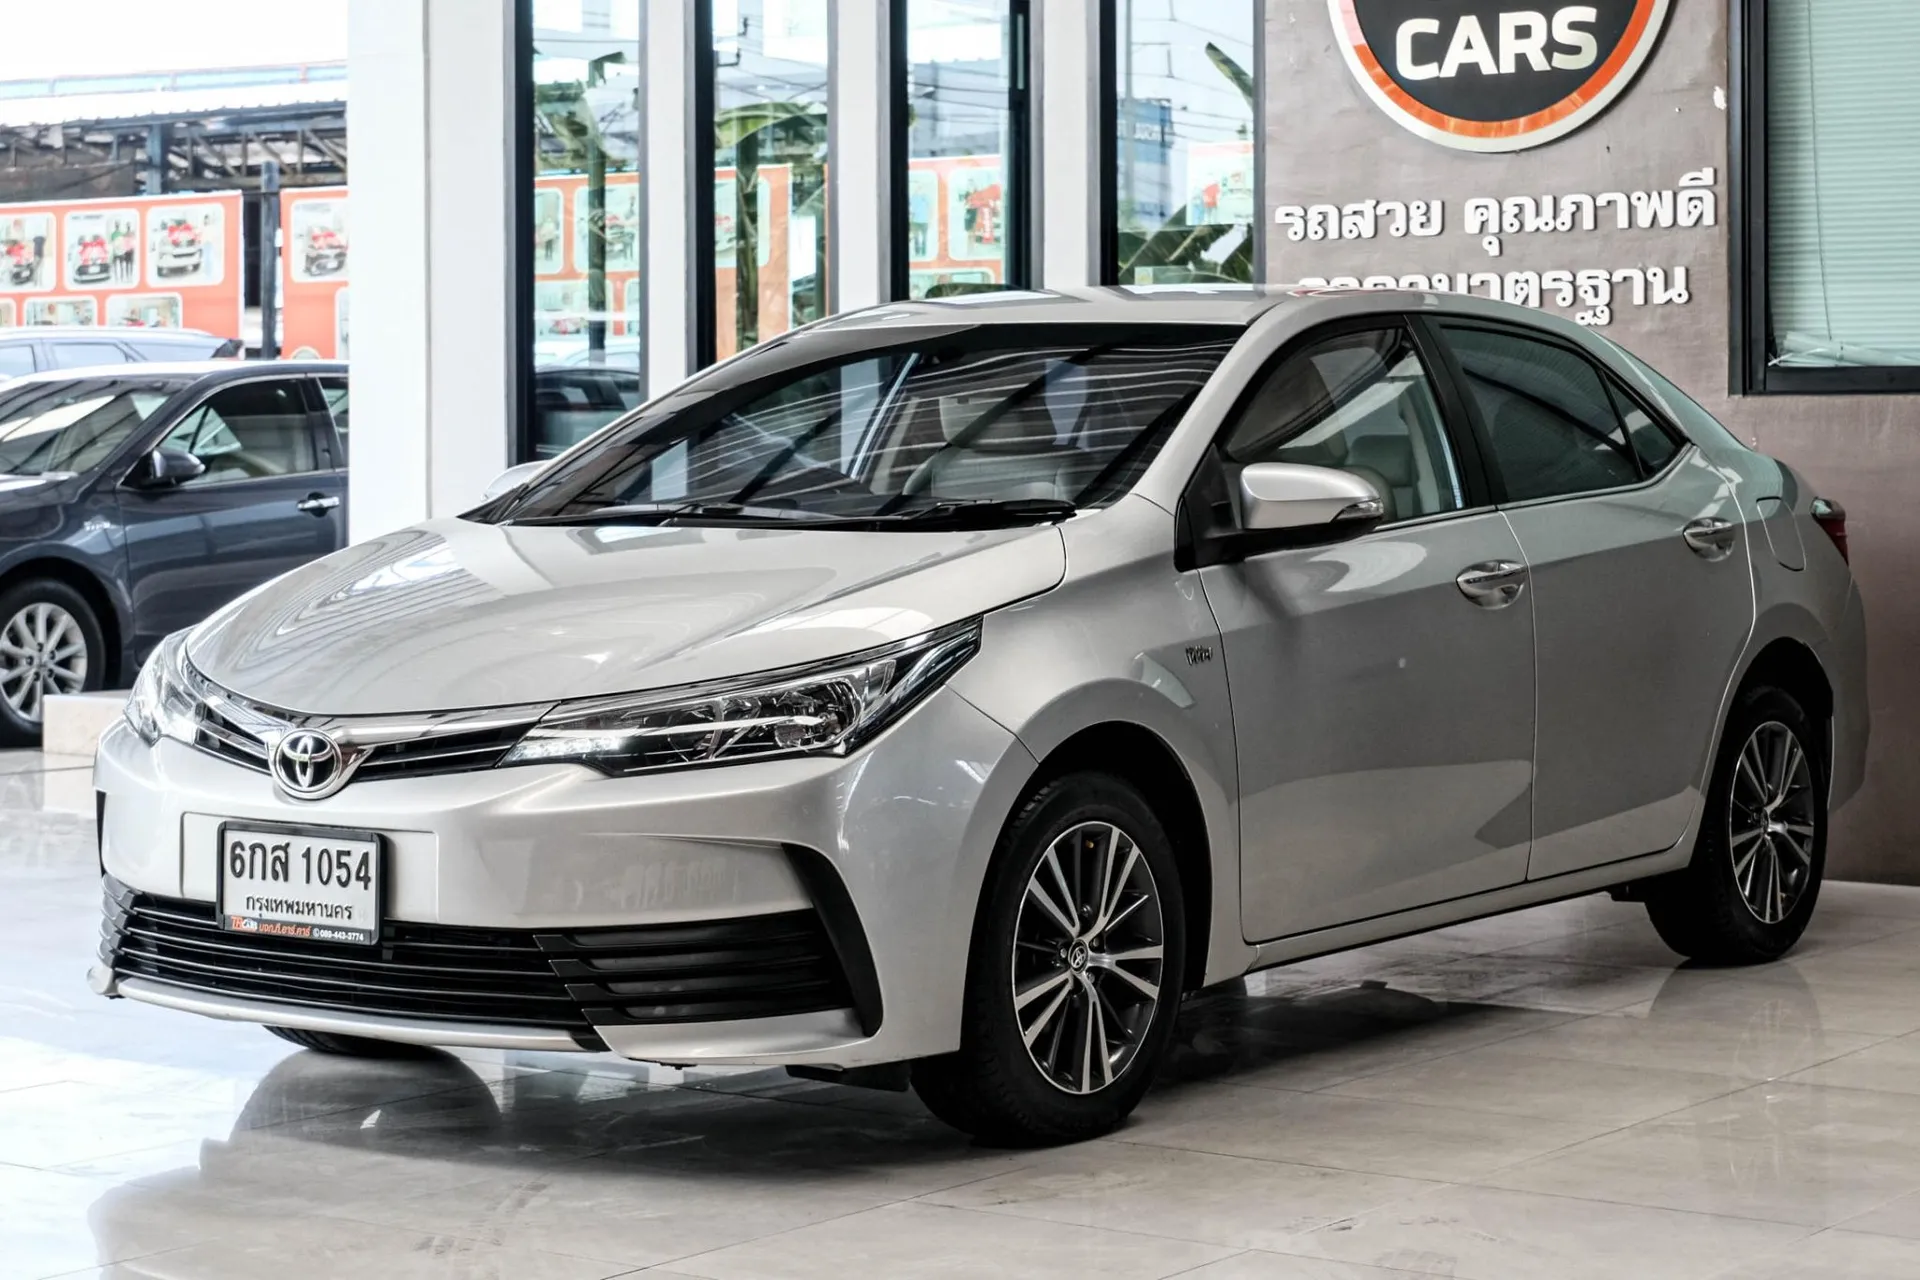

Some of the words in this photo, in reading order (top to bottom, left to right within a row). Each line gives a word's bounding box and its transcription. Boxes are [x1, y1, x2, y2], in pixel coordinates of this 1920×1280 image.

[1396, 7, 1598, 81] CARS
[1275, 199, 1444, 242] รถสวย
[1464, 167, 1717, 257] คุณภาพดี
[1299, 265, 1690, 326] มาตรฐาน
[230, 840, 291, 883] 6กส
[301, 846, 372, 891] 1054
[246, 895, 353, 920] กรุงเทพมหานคร
